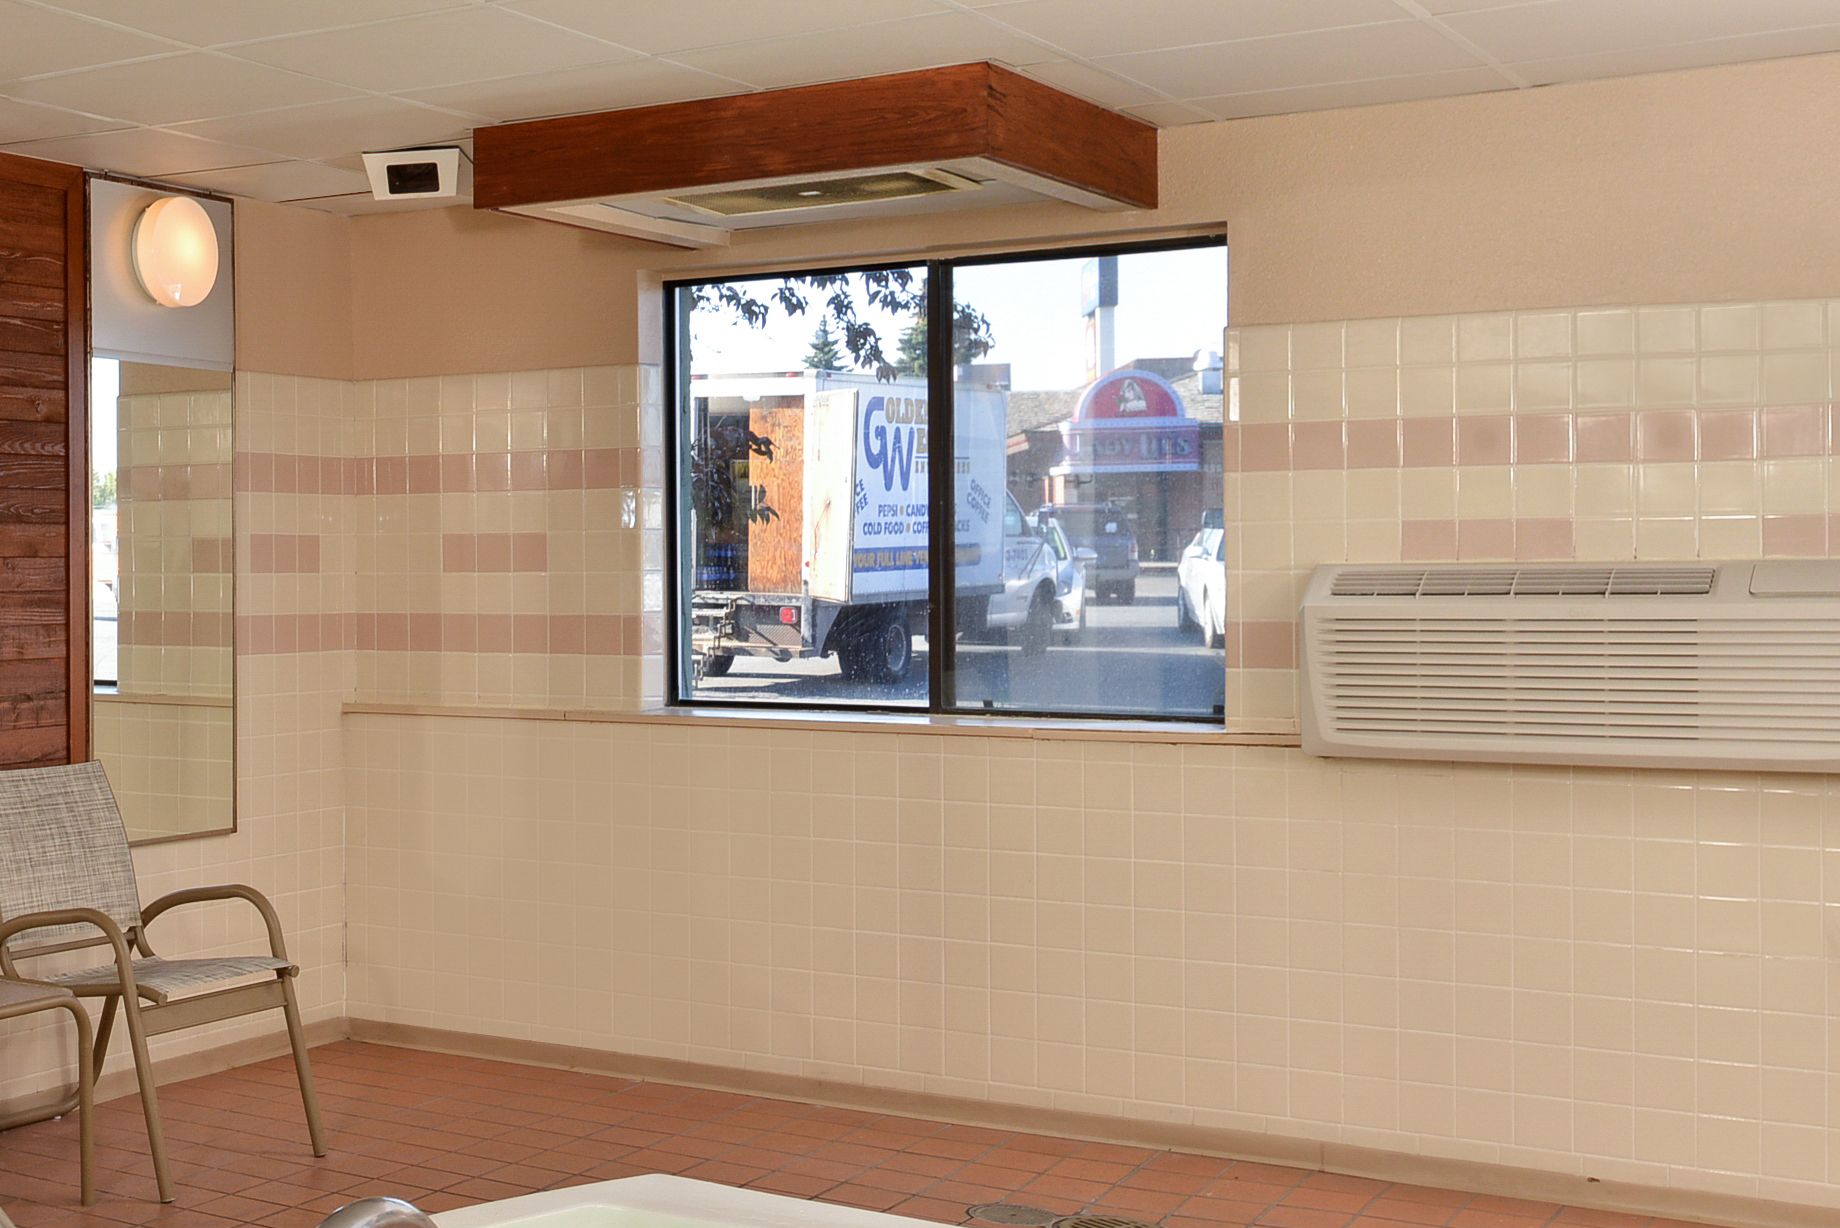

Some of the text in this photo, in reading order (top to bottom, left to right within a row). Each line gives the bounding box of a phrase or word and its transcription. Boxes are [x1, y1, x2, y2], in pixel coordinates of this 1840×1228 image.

[864, 396, 928, 469] GOLDE
[878, 503, 928, 517] PEPSI CAND
[862, 521, 882, 535] COLD
[883, 521, 904, 535] FOOD
